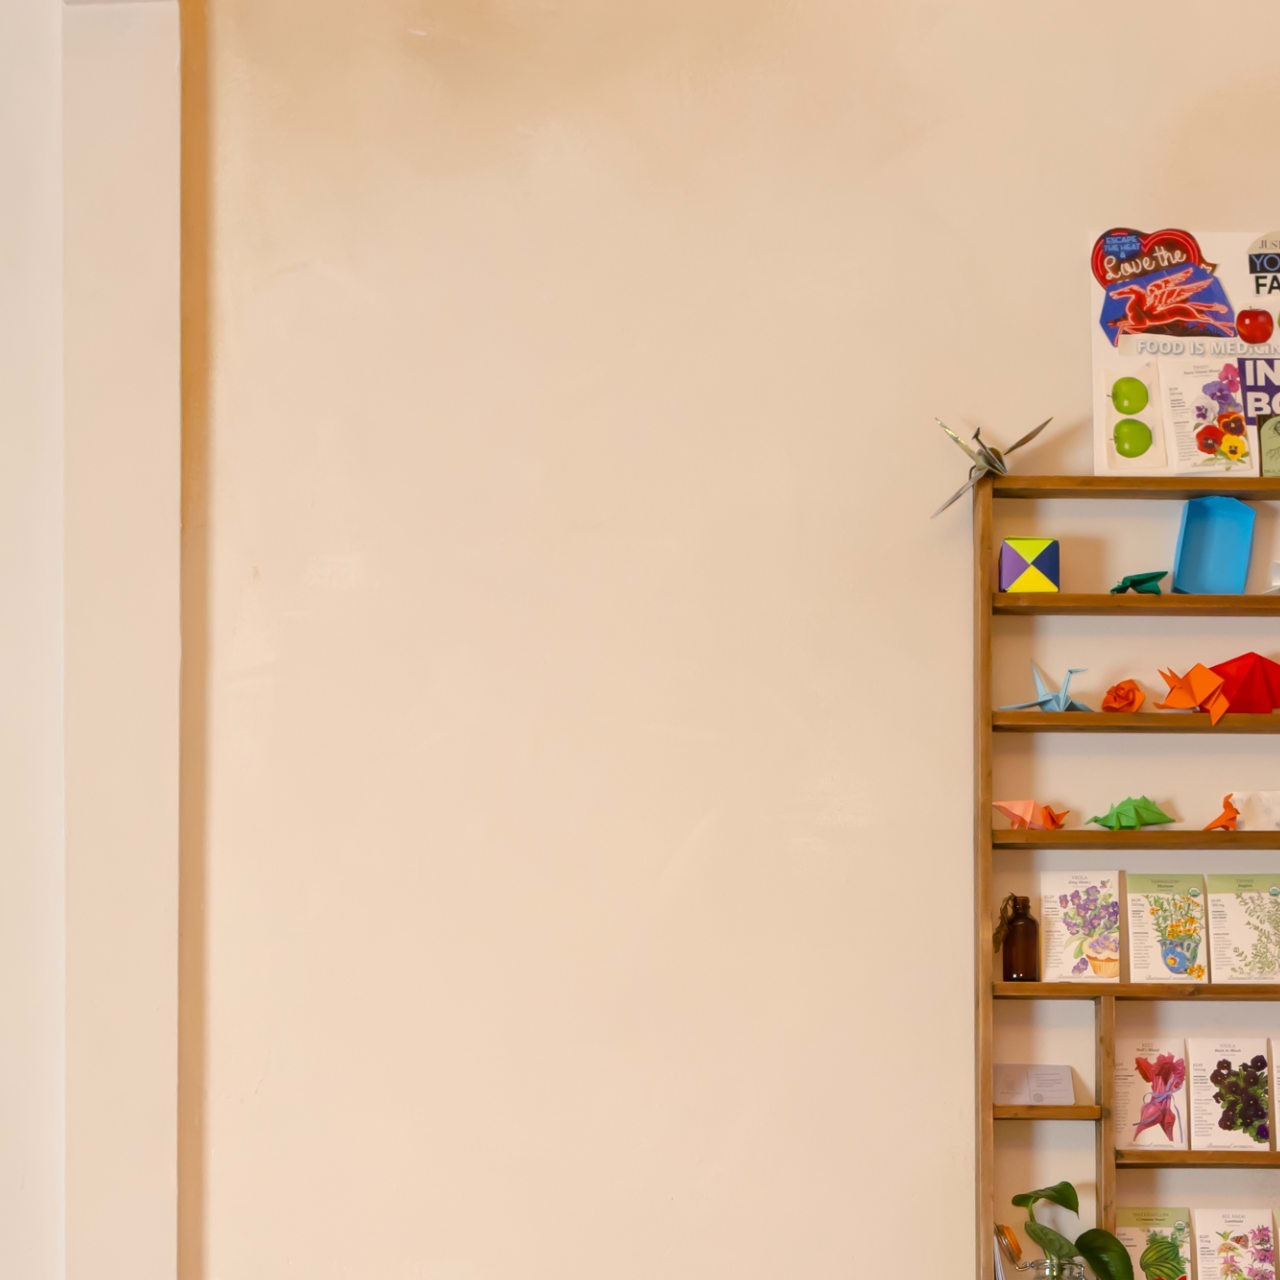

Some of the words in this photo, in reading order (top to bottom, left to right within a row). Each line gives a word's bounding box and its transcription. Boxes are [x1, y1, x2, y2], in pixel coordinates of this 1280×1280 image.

[1104, 256, 1155, 280] Love
[1153, 246, 1186, 266] the
[1138, 341, 1185, 355] FOOD
[1190, 342, 1205, 355] IS
